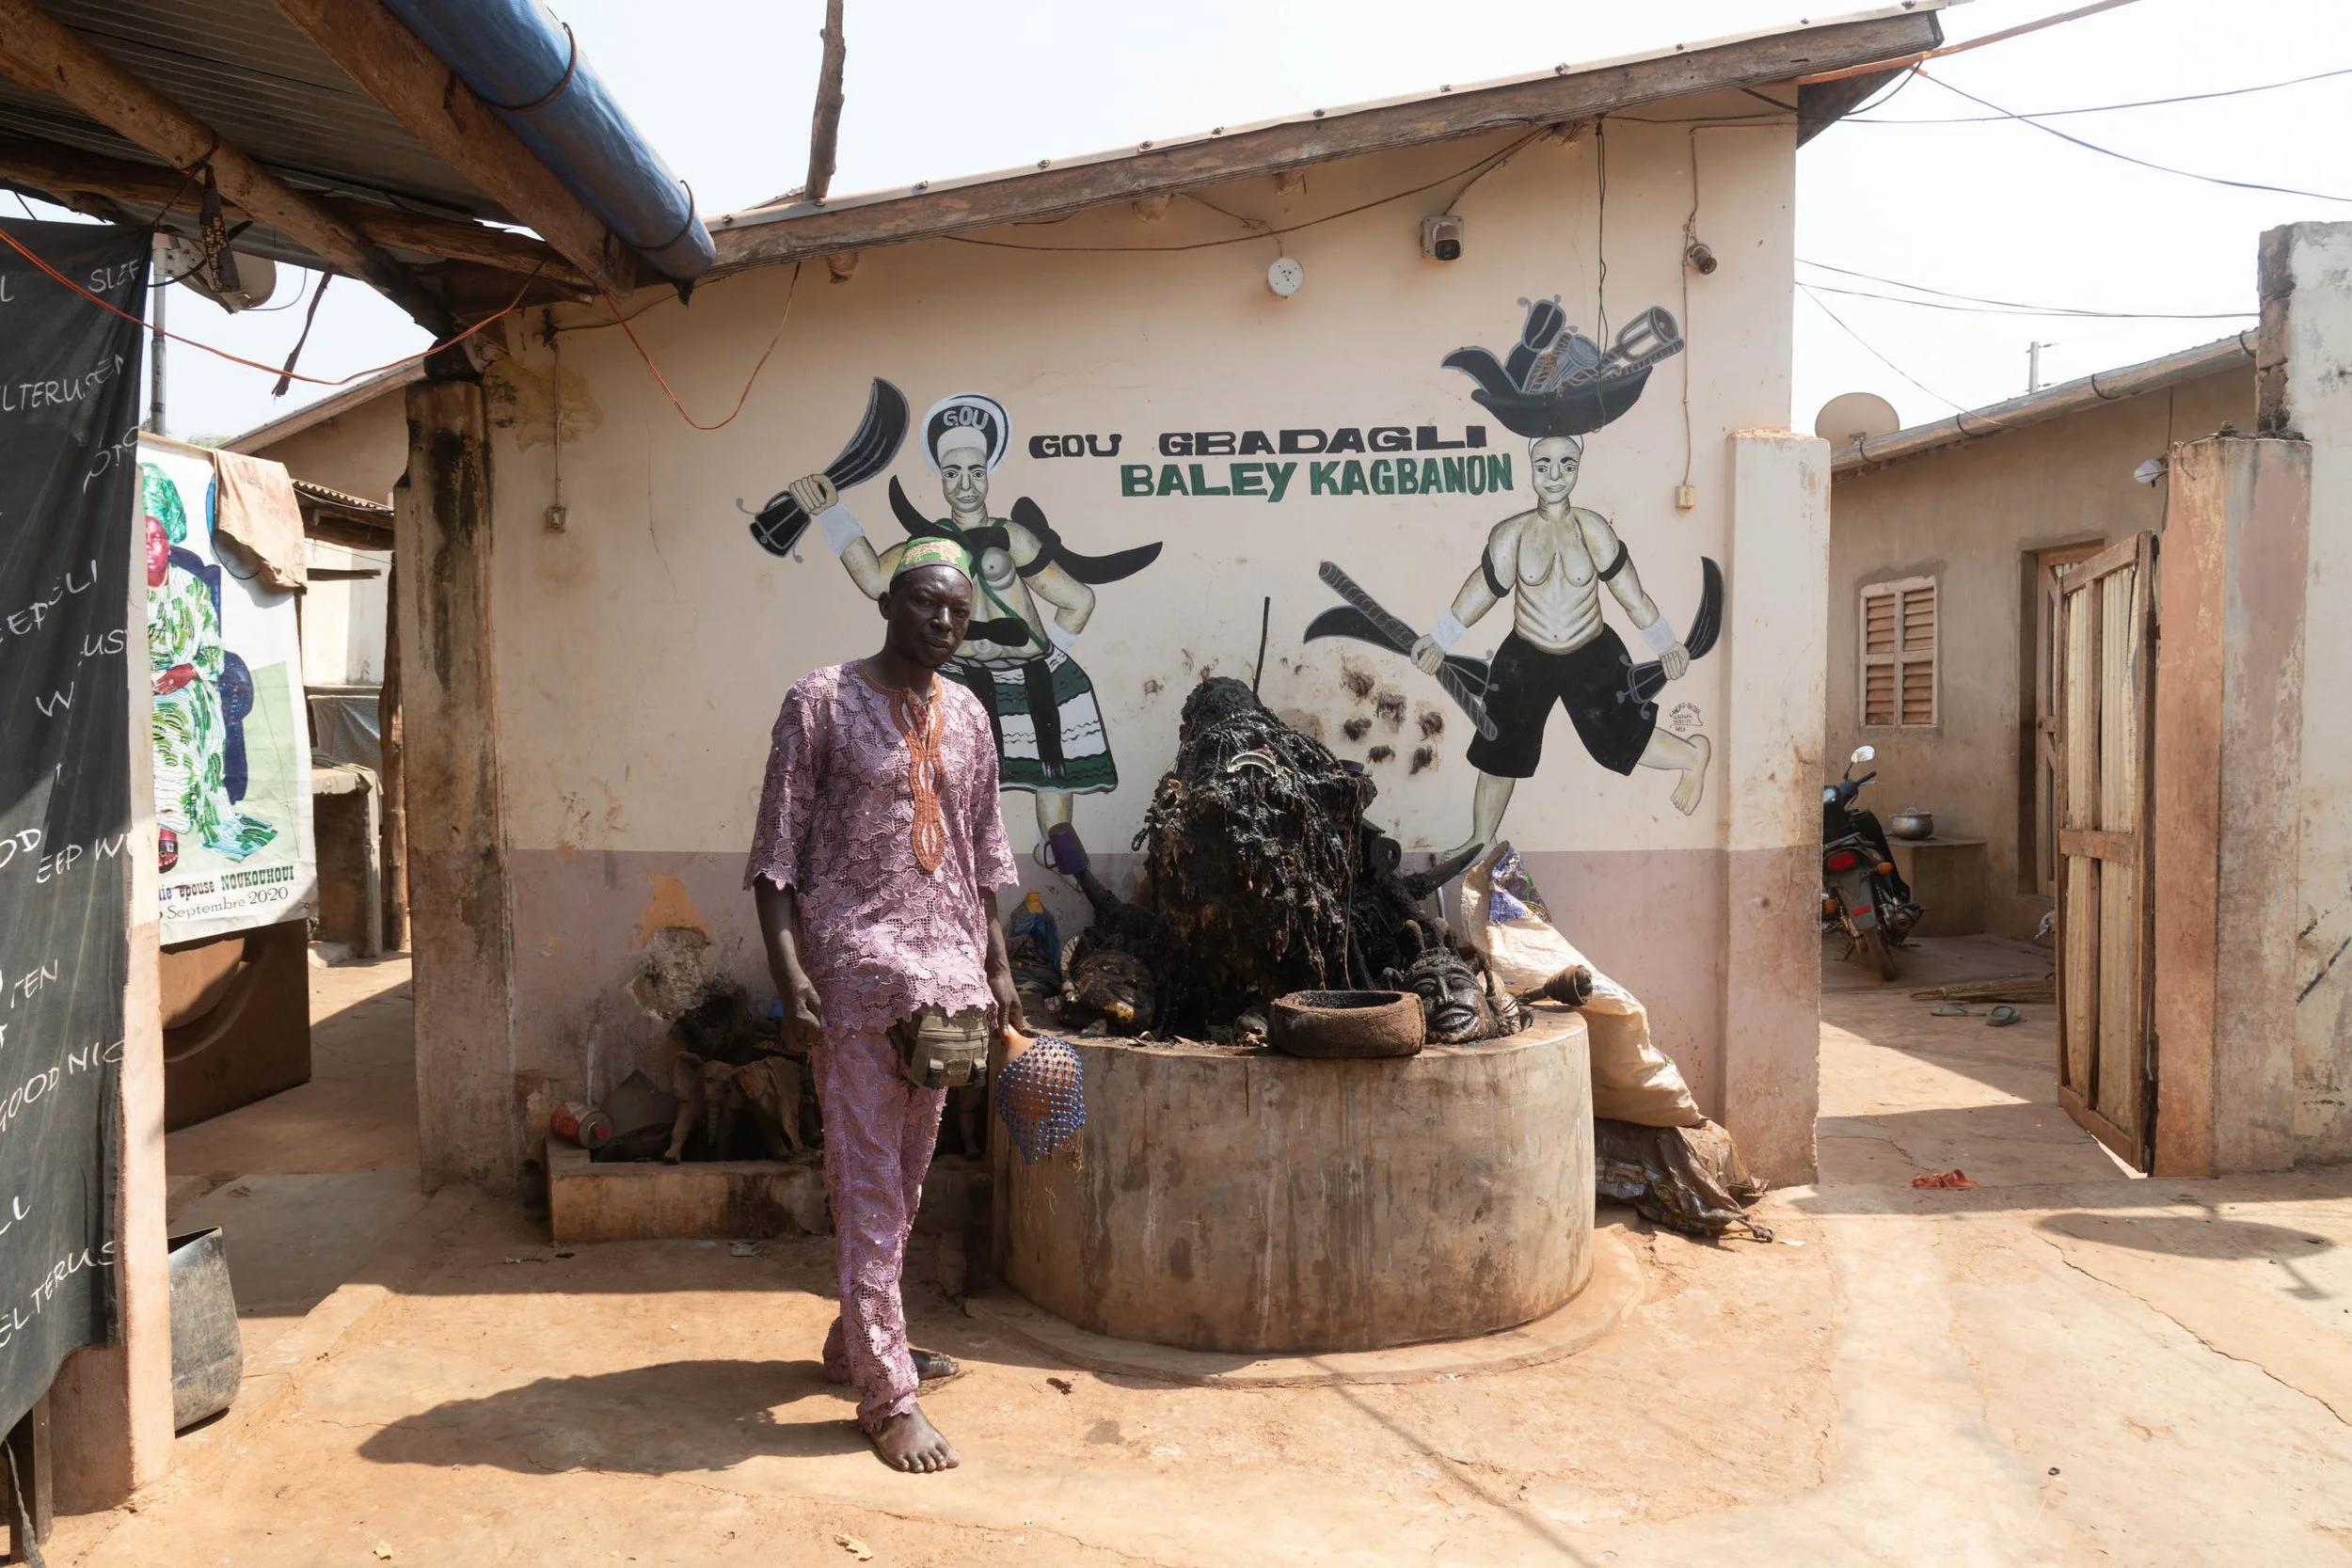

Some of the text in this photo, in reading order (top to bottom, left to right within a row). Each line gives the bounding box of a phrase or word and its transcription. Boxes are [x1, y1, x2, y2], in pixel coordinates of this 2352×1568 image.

[943, 405, 990, 431] GOU
[1028, 426, 1487, 459] GOU GBADAGLI
[1120, 453, 1514, 502] BALEY KAGBANON
[167, 895, 246, 919] Septembre
[248, 886, 289, 905] 2020
